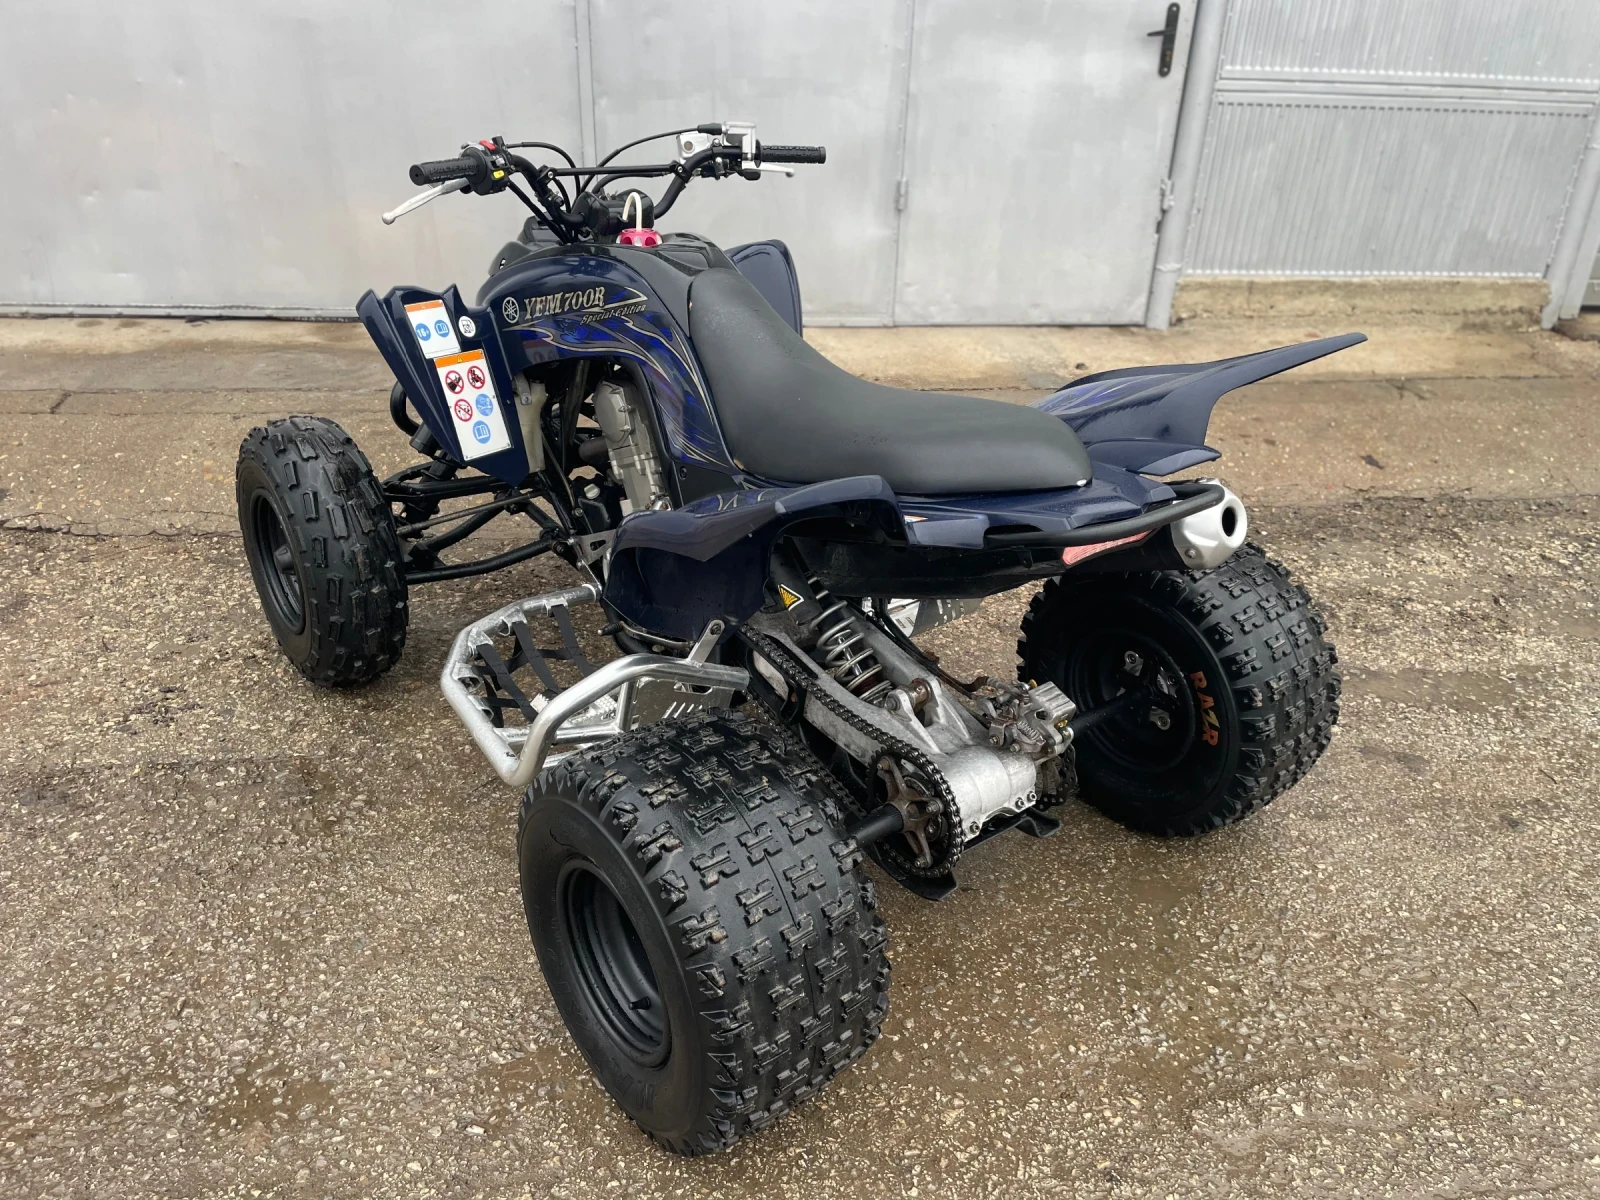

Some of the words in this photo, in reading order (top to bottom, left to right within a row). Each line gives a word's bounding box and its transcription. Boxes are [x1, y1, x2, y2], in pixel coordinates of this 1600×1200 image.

[523, 286, 606, 321] YFM700R
[416, 326, 430, 339] 16+
[1189, 671, 1221, 746] RAZR
